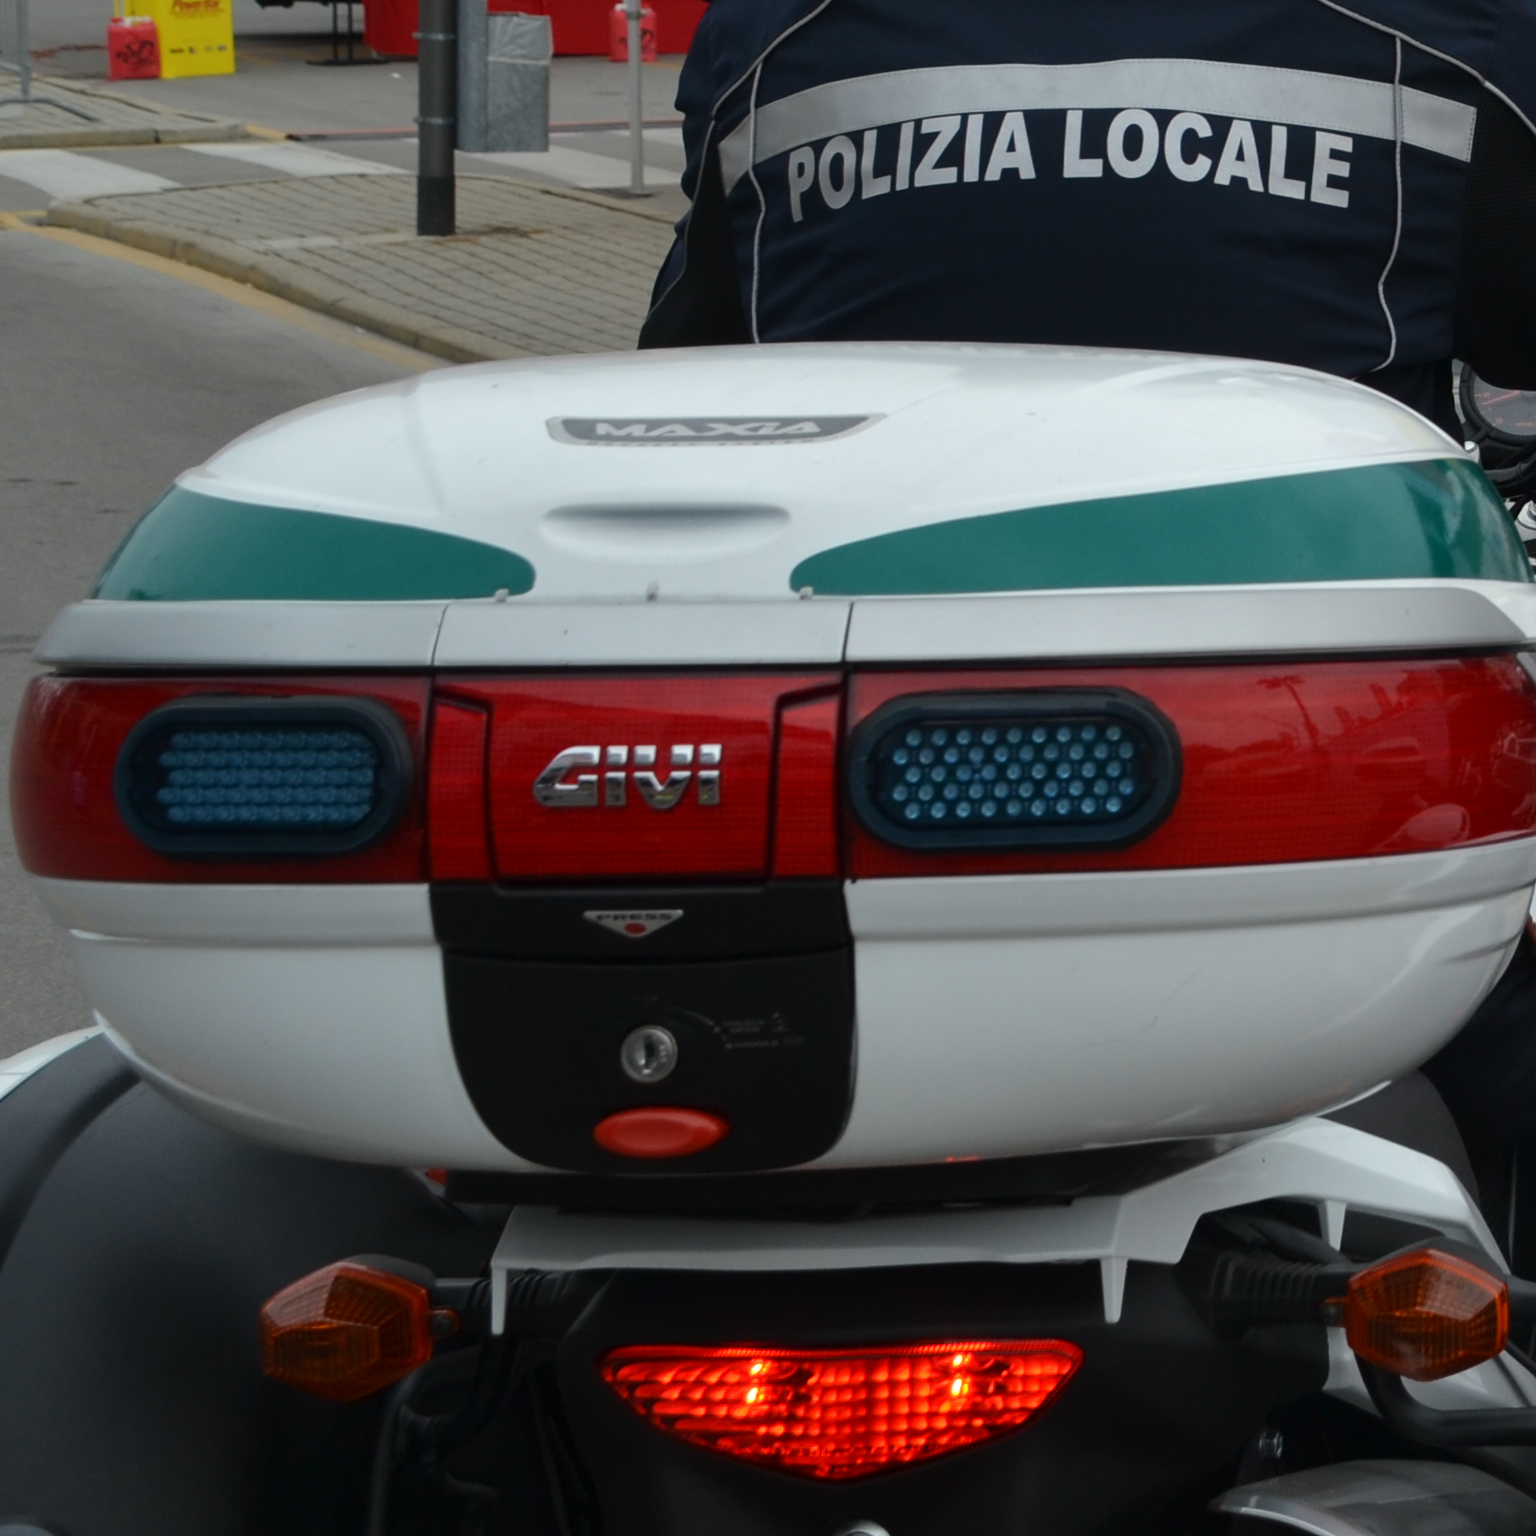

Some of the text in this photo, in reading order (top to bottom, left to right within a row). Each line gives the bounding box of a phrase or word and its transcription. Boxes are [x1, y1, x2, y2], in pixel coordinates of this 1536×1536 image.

[787, 107, 1355, 224] POLIZIA LOCALE
[532, 742, 726, 813] GIVI
